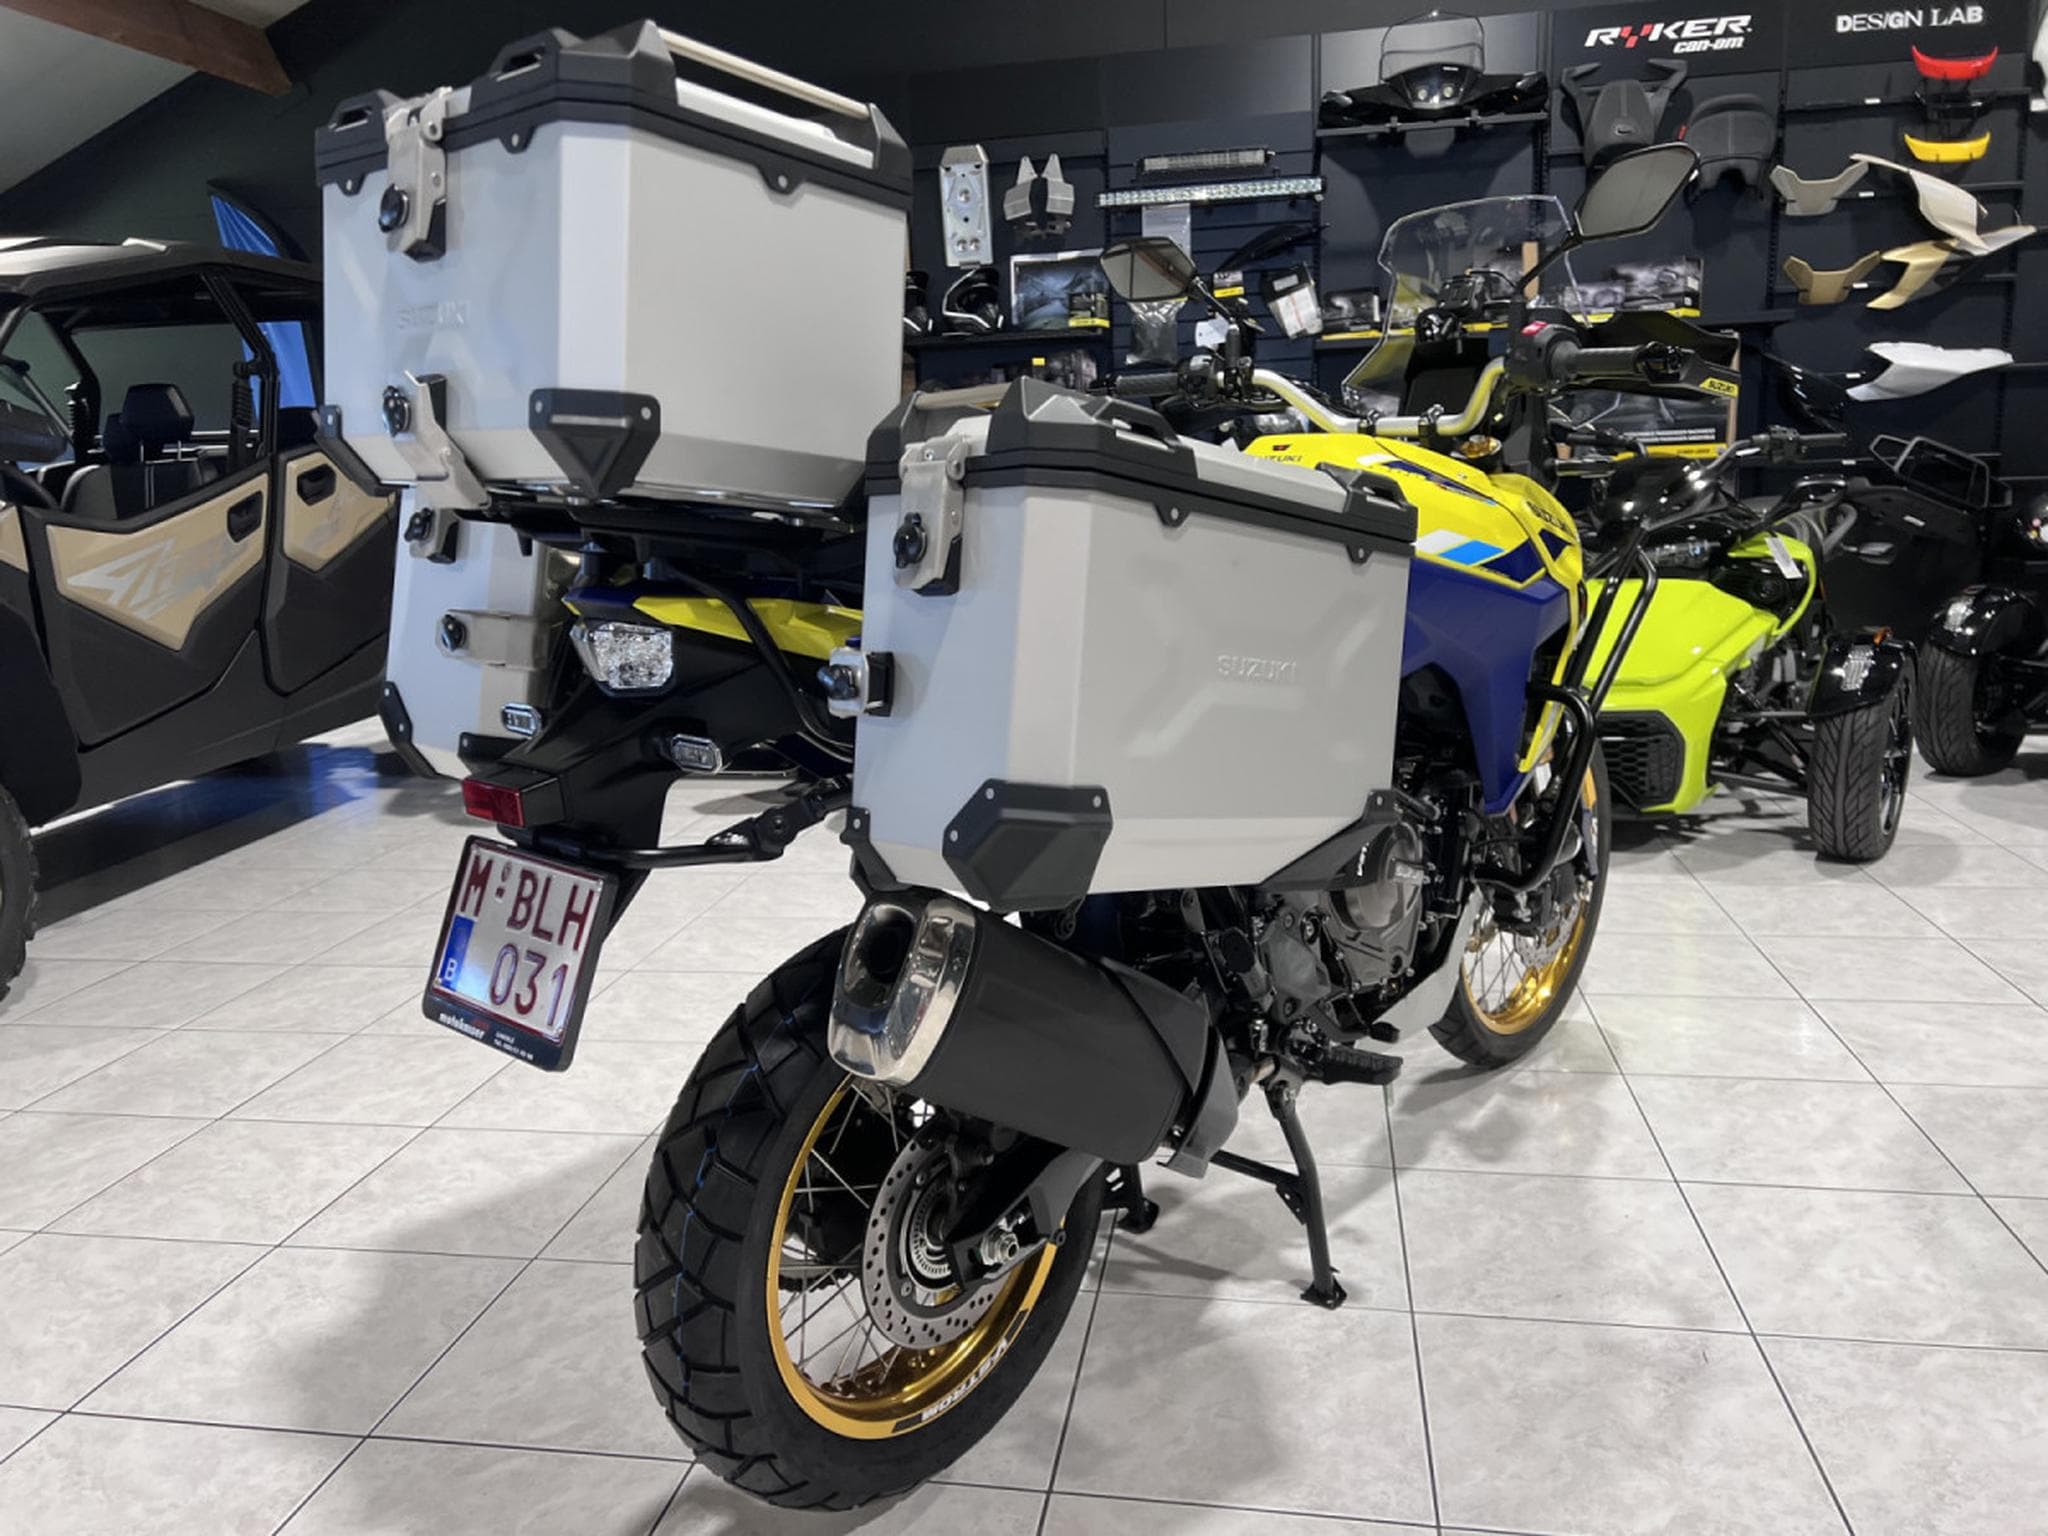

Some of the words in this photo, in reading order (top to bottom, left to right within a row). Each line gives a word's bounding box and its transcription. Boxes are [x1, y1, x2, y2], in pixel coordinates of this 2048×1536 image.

[1584, 15, 1752, 48] RYKER
[1835, 9, 1923, 33] DESIGN
[1929, 5, 1984, 27] LAB
[1217, 655, 1297, 682] SUZUKI
[489, 943, 569, 1027] 031
